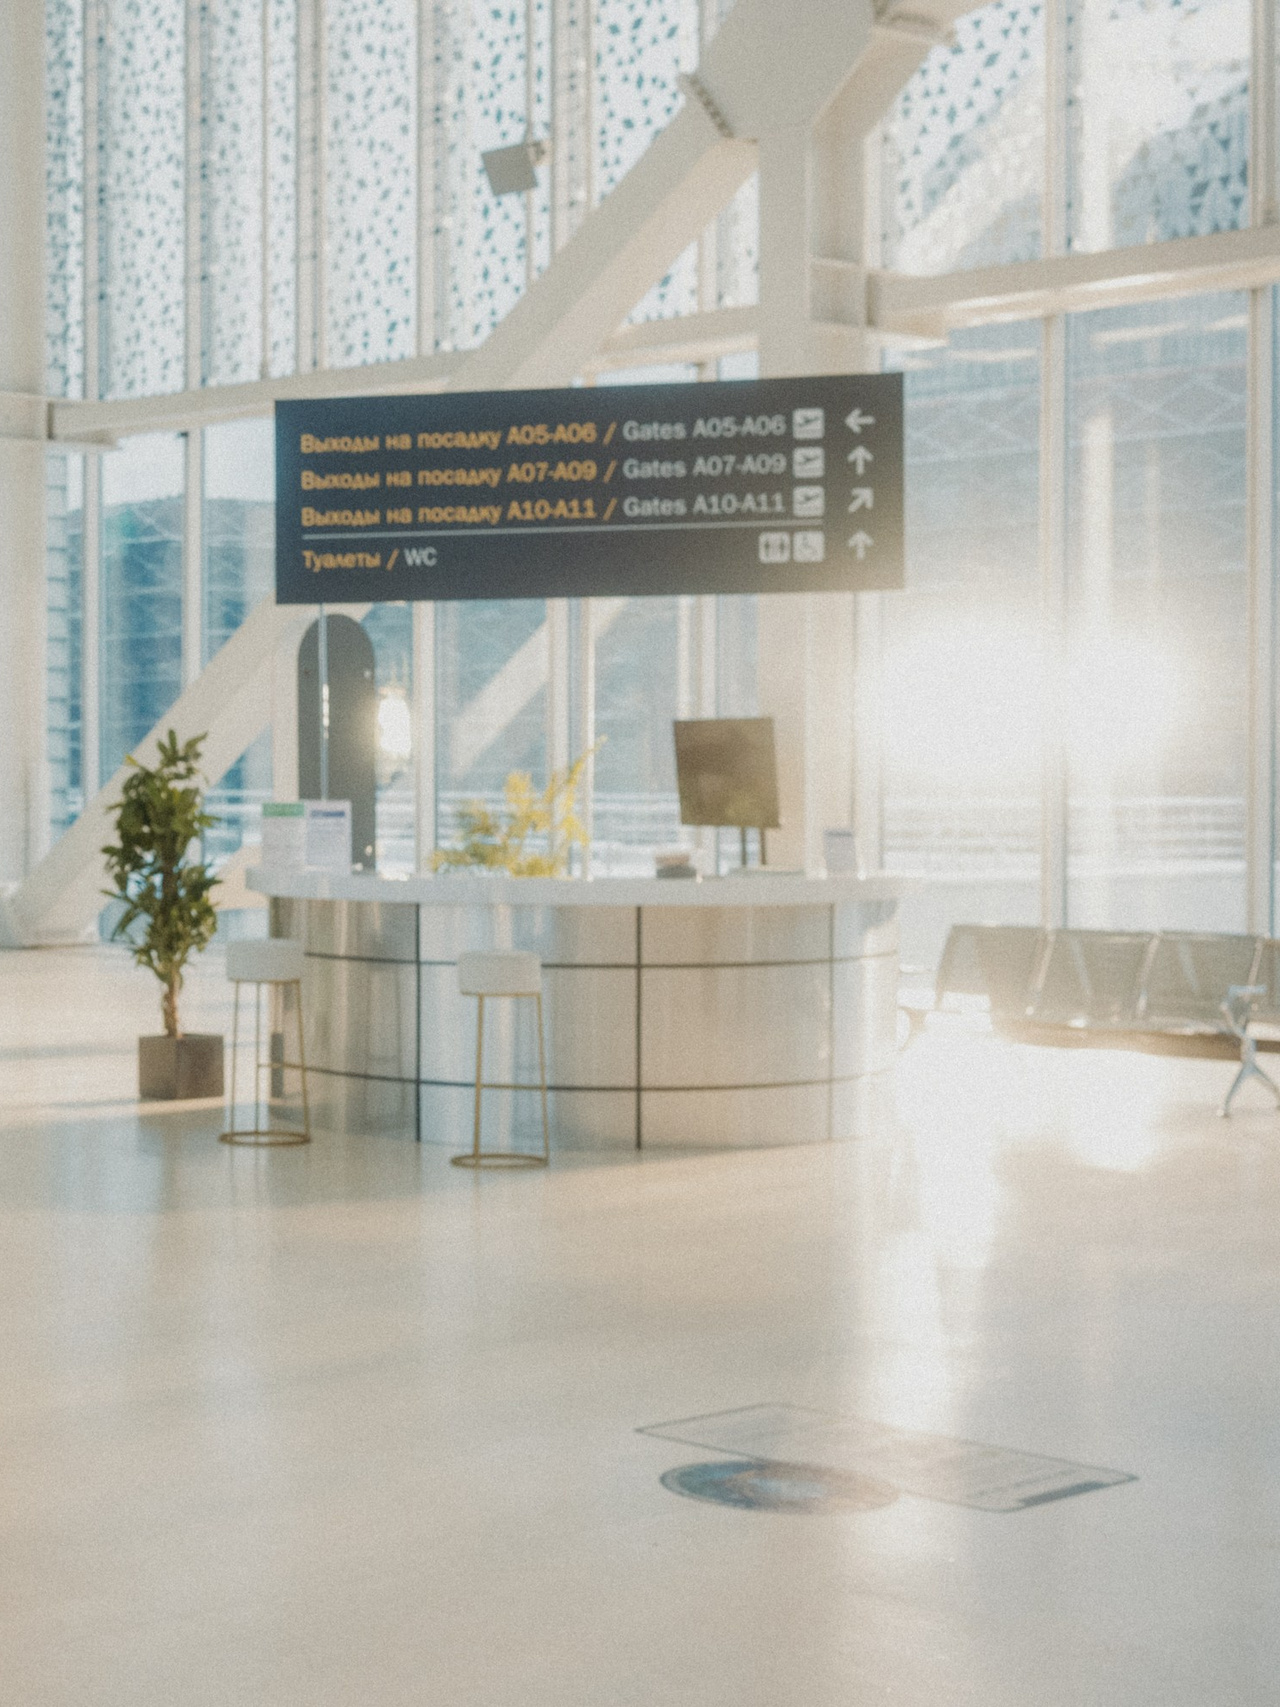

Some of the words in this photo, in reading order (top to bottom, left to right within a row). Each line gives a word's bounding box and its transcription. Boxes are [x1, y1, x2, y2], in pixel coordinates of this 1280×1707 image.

[300, 433, 380, 454] Выходы
[385, 434, 412, 450] на
[417, 430, 502, 450] посадку
[602, 420, 617, 447] /
[622, 419, 686, 441] Gates
[300, 470, 381, 490] Выходы
[385, 471, 412, 488] на
[417, 467, 502, 489] посадку
[506, 459, 598, 483] A07-A09
[602, 459, 617, 484] /
[622, 457, 687, 479] Gates
[692, 452, 787, 477] A07-A09
[301, 507, 381, 527] Выходы
[385, 508, 412, 524] на
[417, 505, 502, 526] посадку
[506, 498, 596, 521] A10-A11
[602, 497, 617, 521] /
[622, 496, 687, 518] Gates
[692, 491, 786, 515] A10-A11
[302, 550, 381, 573] Туалеты
[385, 548, 399, 571] /
[404, 546, 438, 568] WC
